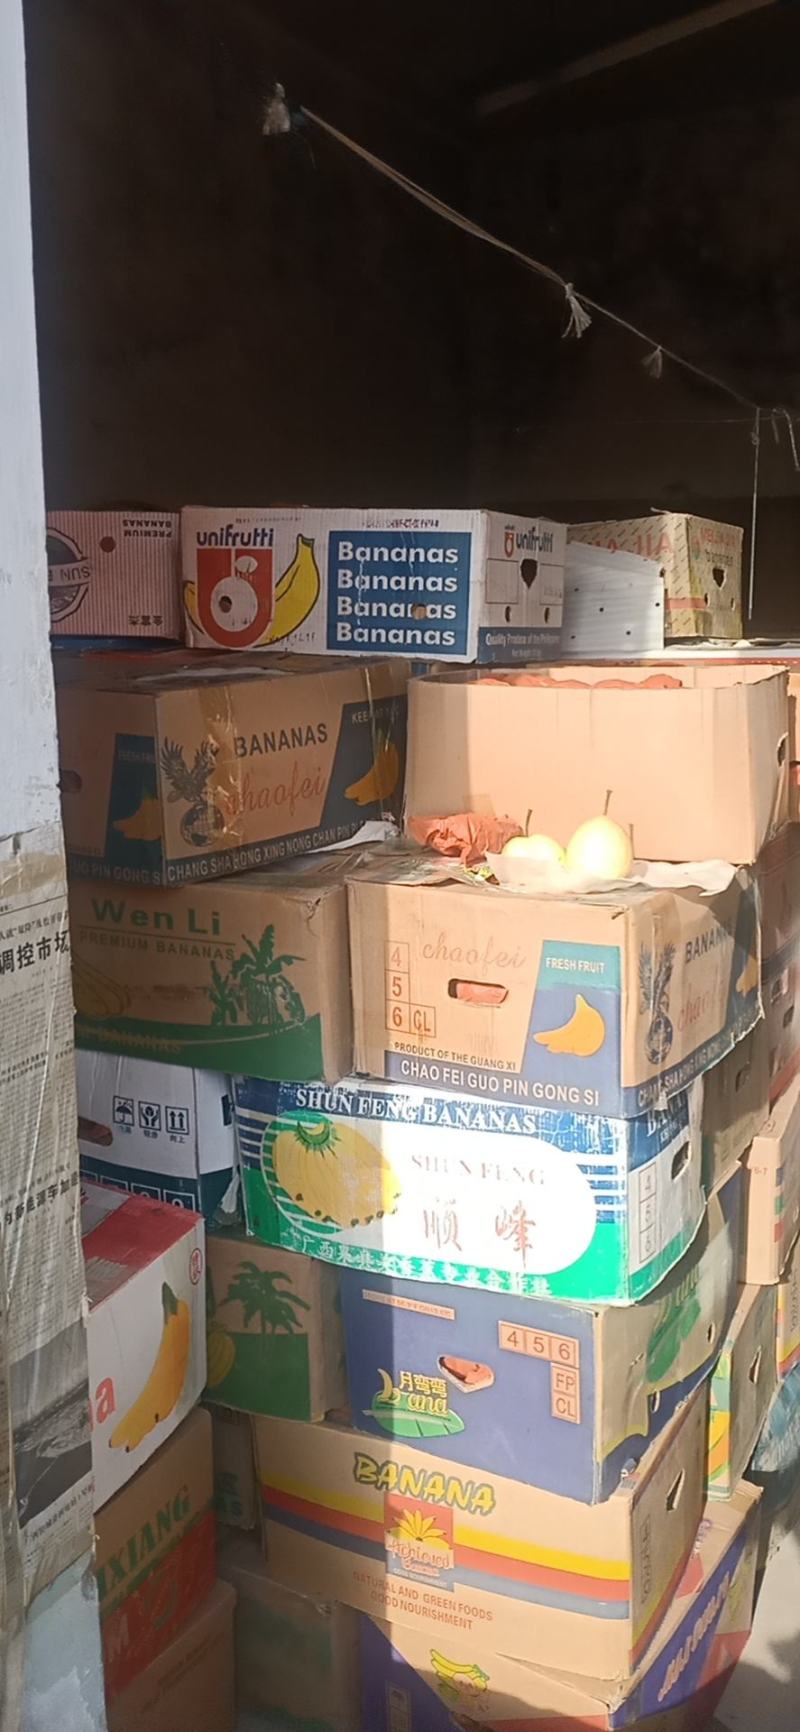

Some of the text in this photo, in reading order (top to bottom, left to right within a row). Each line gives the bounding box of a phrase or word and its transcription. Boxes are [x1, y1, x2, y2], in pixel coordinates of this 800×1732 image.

[123, 529, 172, 538] PREMIUM
[196, 524, 274, 547] unifrutti
[338, 541, 459, 563] Bananas
[337, 568, 458, 592] Bananas
[336, 622, 456, 646] Bananas
[233, 723, 328, 758] BANANAS
[167, 860, 209, 881] CHANG
[210, 853, 232, 875] SHA
[263, 842, 286, 862] XING
[91, 898, 174, 930] Wen
[187, 908, 220, 936] Li
[79, 930, 236, 962] PREMIUM BANANAS
[390, 945, 401, 967] 4
[422, 933, 528, 976] chaofei
[545, 957, 605, 974] FRESH FRUIT
[391, 976, 402, 997] 5
[392, 1006, 402, 1027] 6
[394, 1041, 516, 1071] PRODUCT OF THE GUANG XI
[401, 1059, 599, 1107] CHAO FEI GUO PIN GONG SI
[295, 1088, 352, 1117] SHUN
[358, 1095, 418, 1122] FENG
[423, 1102, 536, 1135] BANANAS
[506, 1330, 571, 1361] 4 5 6
[555, 1372, 575, 1391] FP
[555, 1397, 577, 1418] CL
[353, 1451, 496, 1517] BANANA
[352, 1571, 399, 1594] NATURAL
[398, 1586, 420, 1601] AND
[422, 1593, 457, 1611] GREEN
[458, 1602, 494, 1621] FOODS
[370, 1590, 473, 1630] GOOD NOURISHMENT
